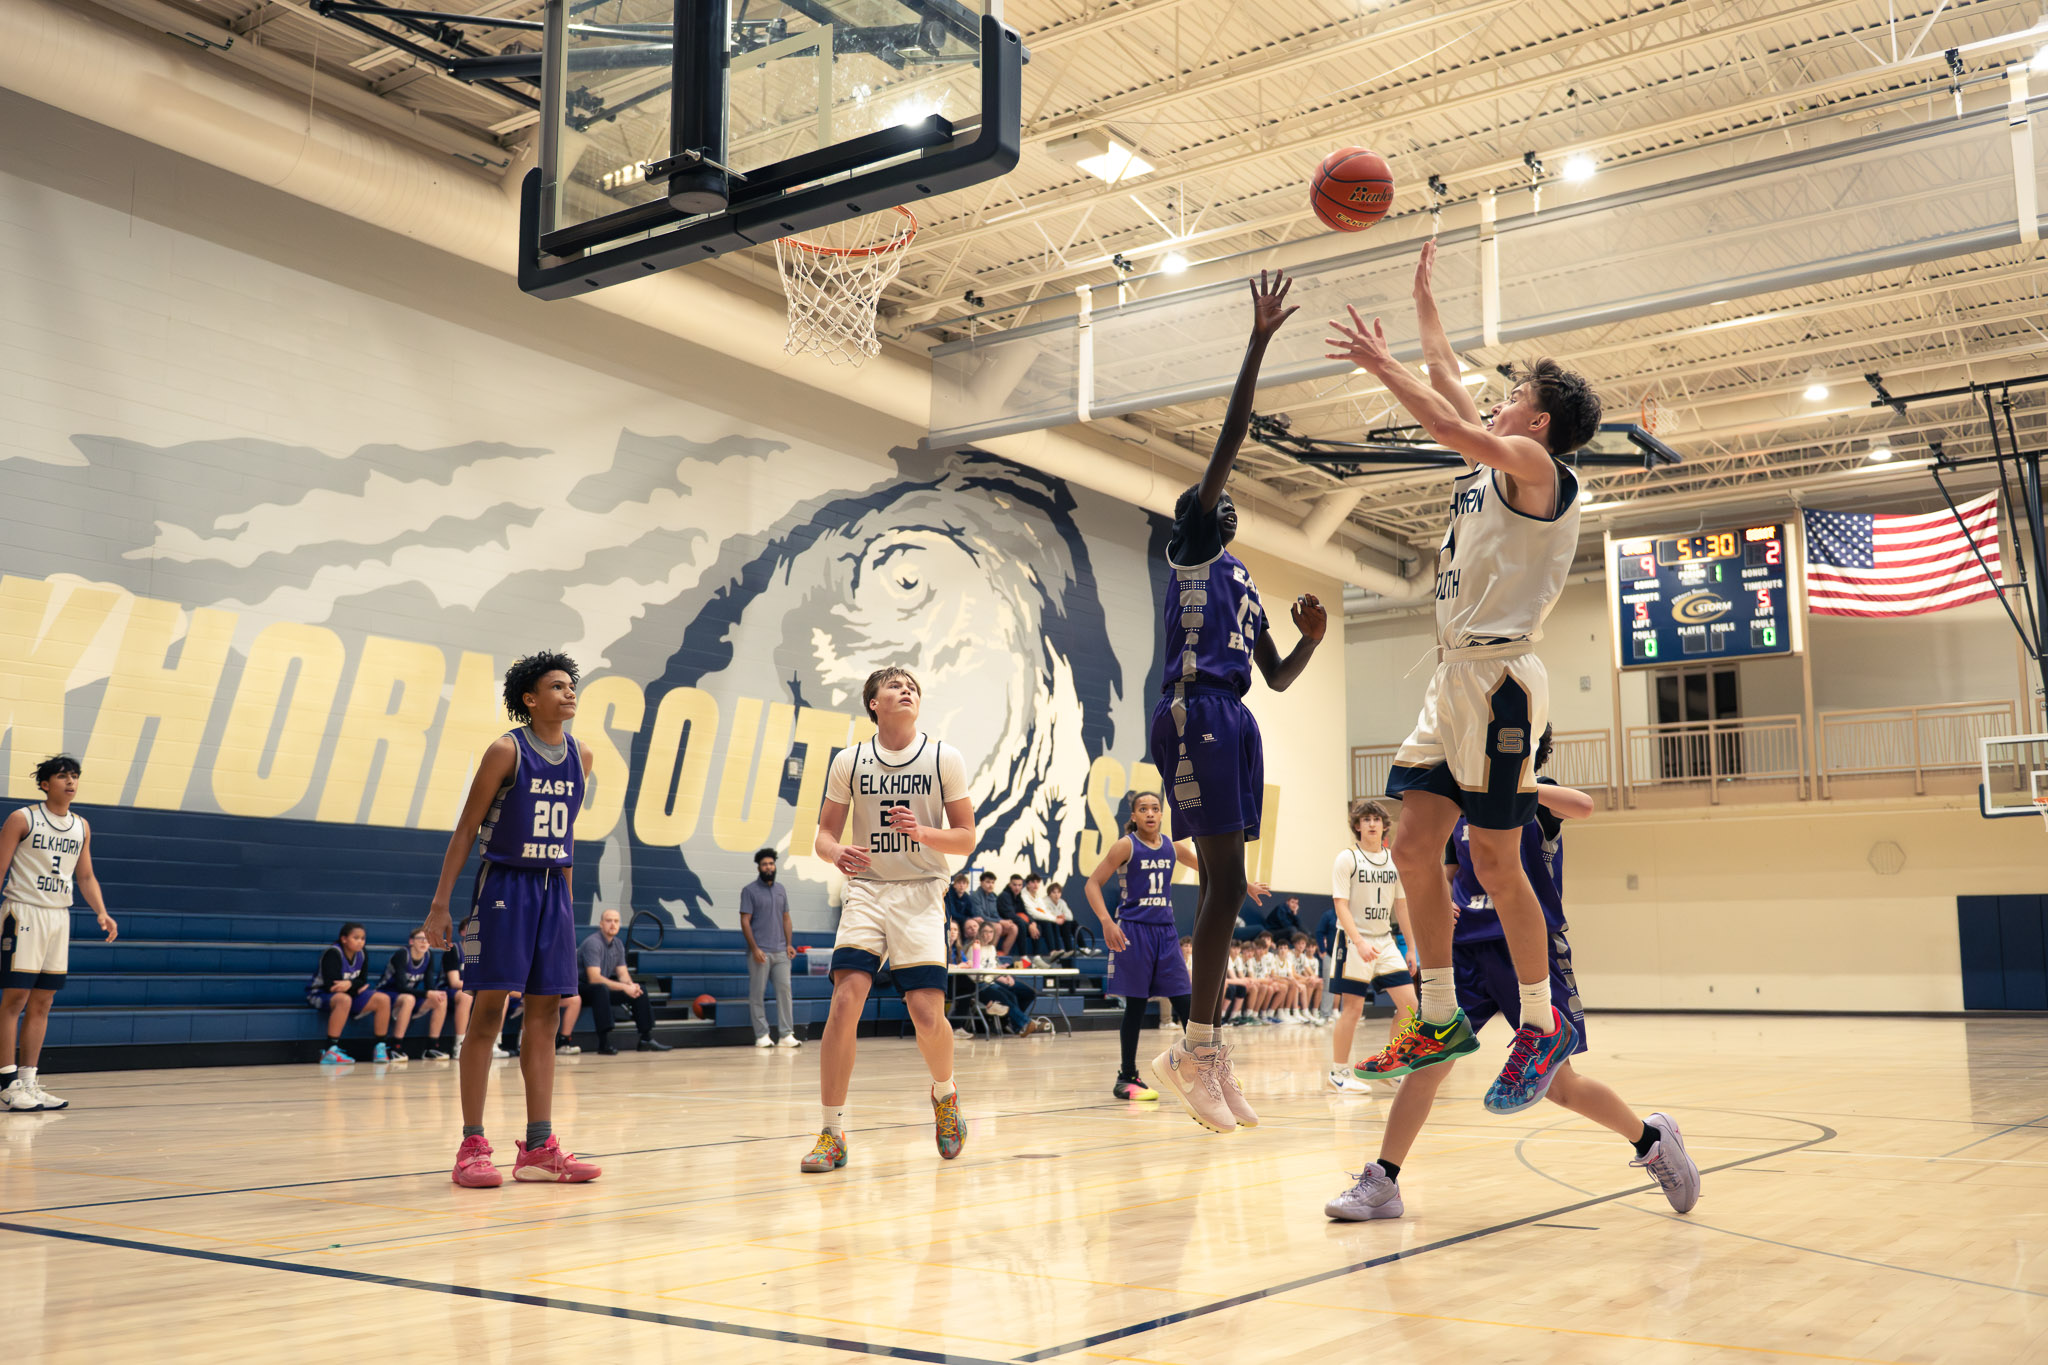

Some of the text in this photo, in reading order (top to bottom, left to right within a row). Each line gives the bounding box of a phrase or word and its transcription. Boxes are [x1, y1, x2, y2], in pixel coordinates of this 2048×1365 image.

[1677, 533, 1735, 561] 5:30
[1765, 540, 1781, 565] 2
[1640, 554, 1656, 578] 9
[1715, 564, 1722, 582] 1
[1741, 567, 1768, 578] BONUS
[1743, 579, 1783, 591] TIMEOUTS
[1622, 592, 1660, 604] TIMEOUTS
[1697, 601, 1732, 613] STORM
[1757, 588, 1771, 608] 5
[1635, 602, 1648, 620] 5
[1755, 606, 1774, 617] LEFT
[1632, 619, 1651, 629] LEFT
[1677, 622, 1735, 636] PLAYER FOULS
[1750, 618, 1775, 629] FOULS
[1633, 630, 1656, 640] FOULS
[1763, 627, 1777, 647] 0
[1645, 638, 1658, 658] 0
[568, 676, 881, 857] SOUT
[529, 778, 575, 797] EAST
[860, 774, 932, 796] ELKHORN
[532, 800, 569, 838] 20
[32, 833, 81, 856] ELKHORN
[870, 832, 921, 854] SOUTH
[51, 856, 62, 875] 3
[1140, 859, 1171, 870] EAST
[1148, 871, 1164, 895] 11
[1358, 869, 1398, 884] ELKHORN
[1377, 887, 1381, 904] 1
